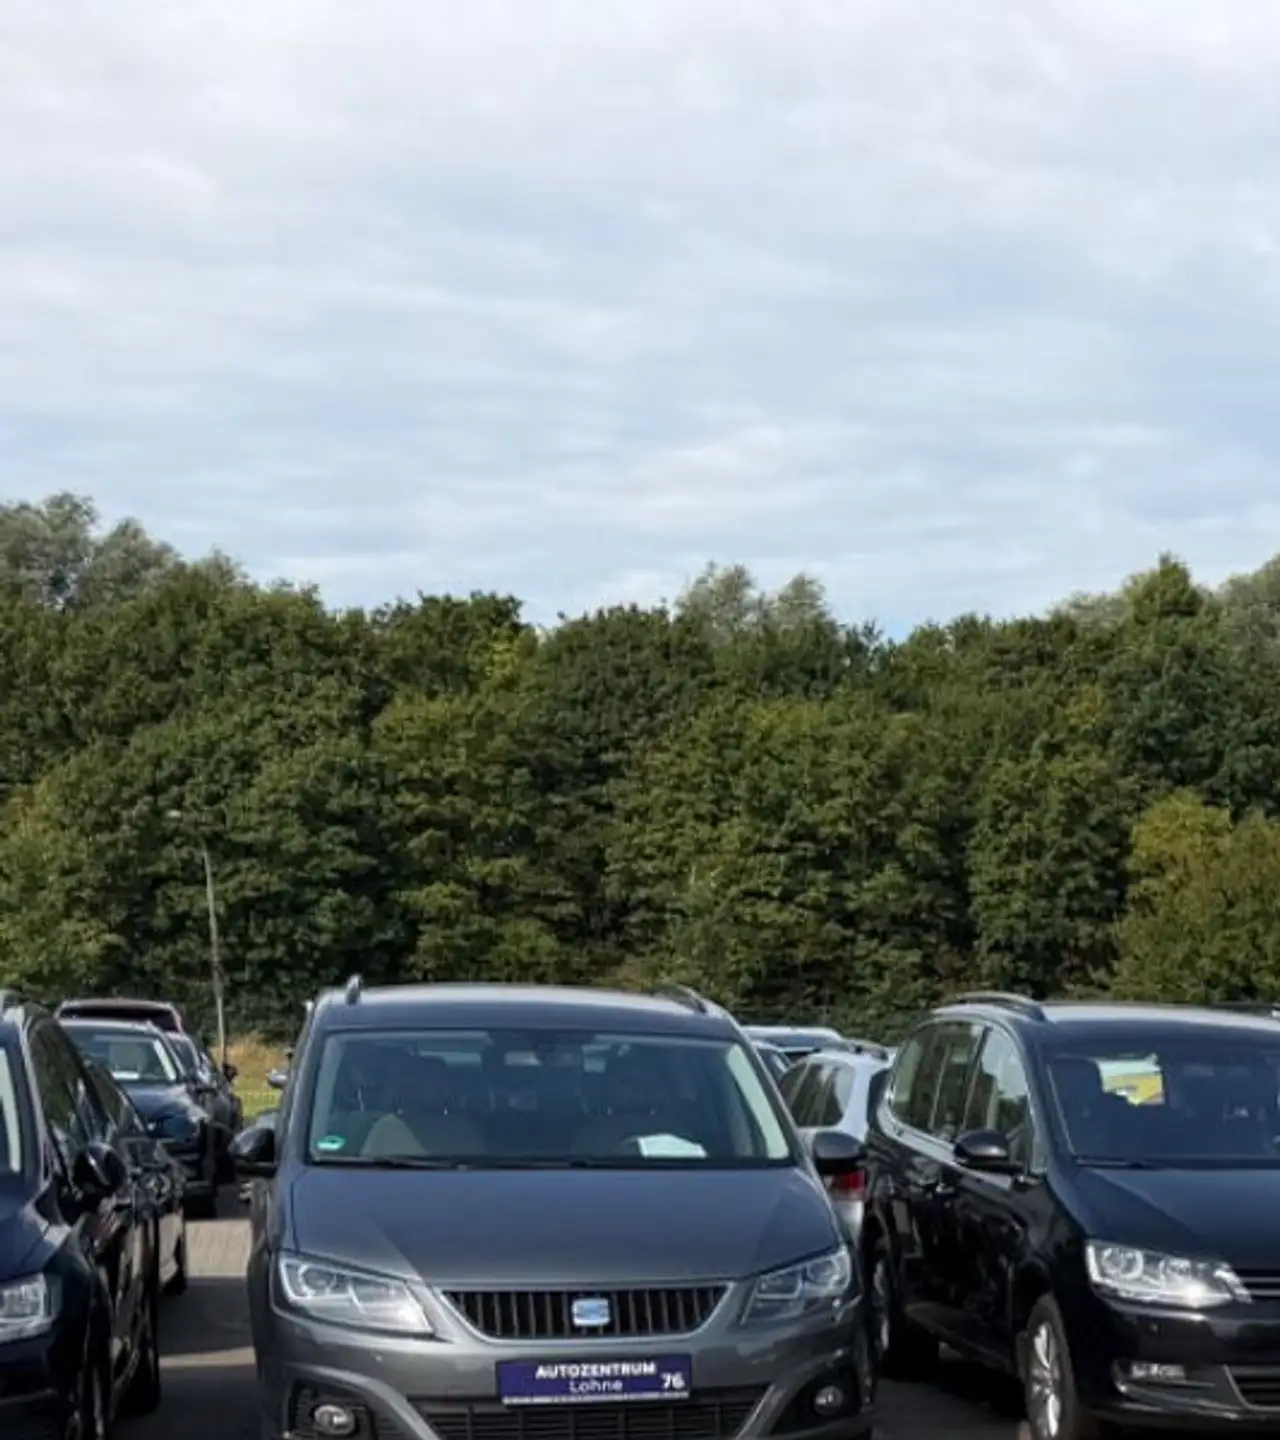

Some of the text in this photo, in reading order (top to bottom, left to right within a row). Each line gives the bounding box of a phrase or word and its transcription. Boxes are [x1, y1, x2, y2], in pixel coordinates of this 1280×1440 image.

[535, 1361, 656, 1380] AUTOZENTRUM
[569, 1372, 686, 1394] Lohne 76
